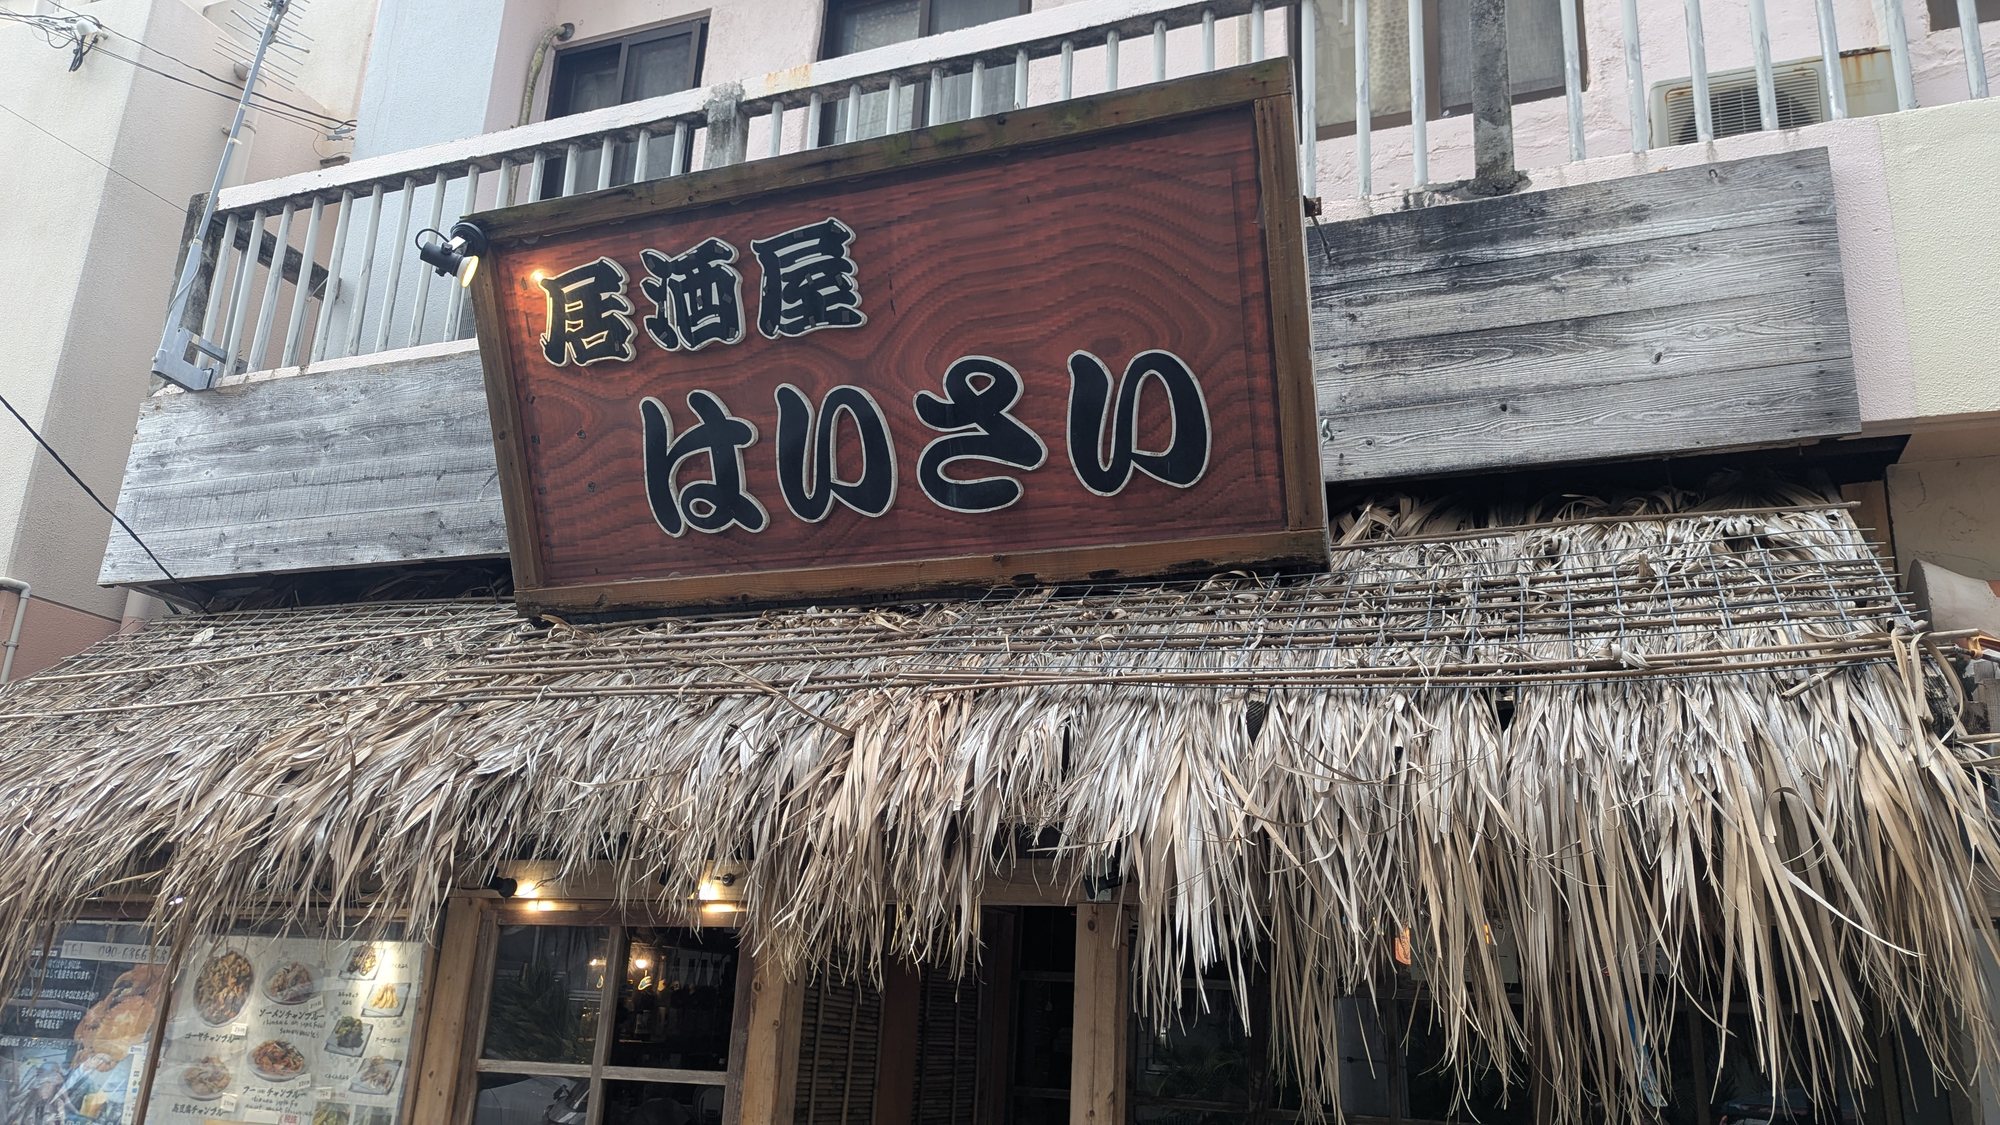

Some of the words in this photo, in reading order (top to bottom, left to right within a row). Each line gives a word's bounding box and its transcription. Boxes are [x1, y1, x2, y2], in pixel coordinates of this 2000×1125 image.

[539, 217, 867, 366] 居酒屋
[640, 349, 1212, 537] はいさい
